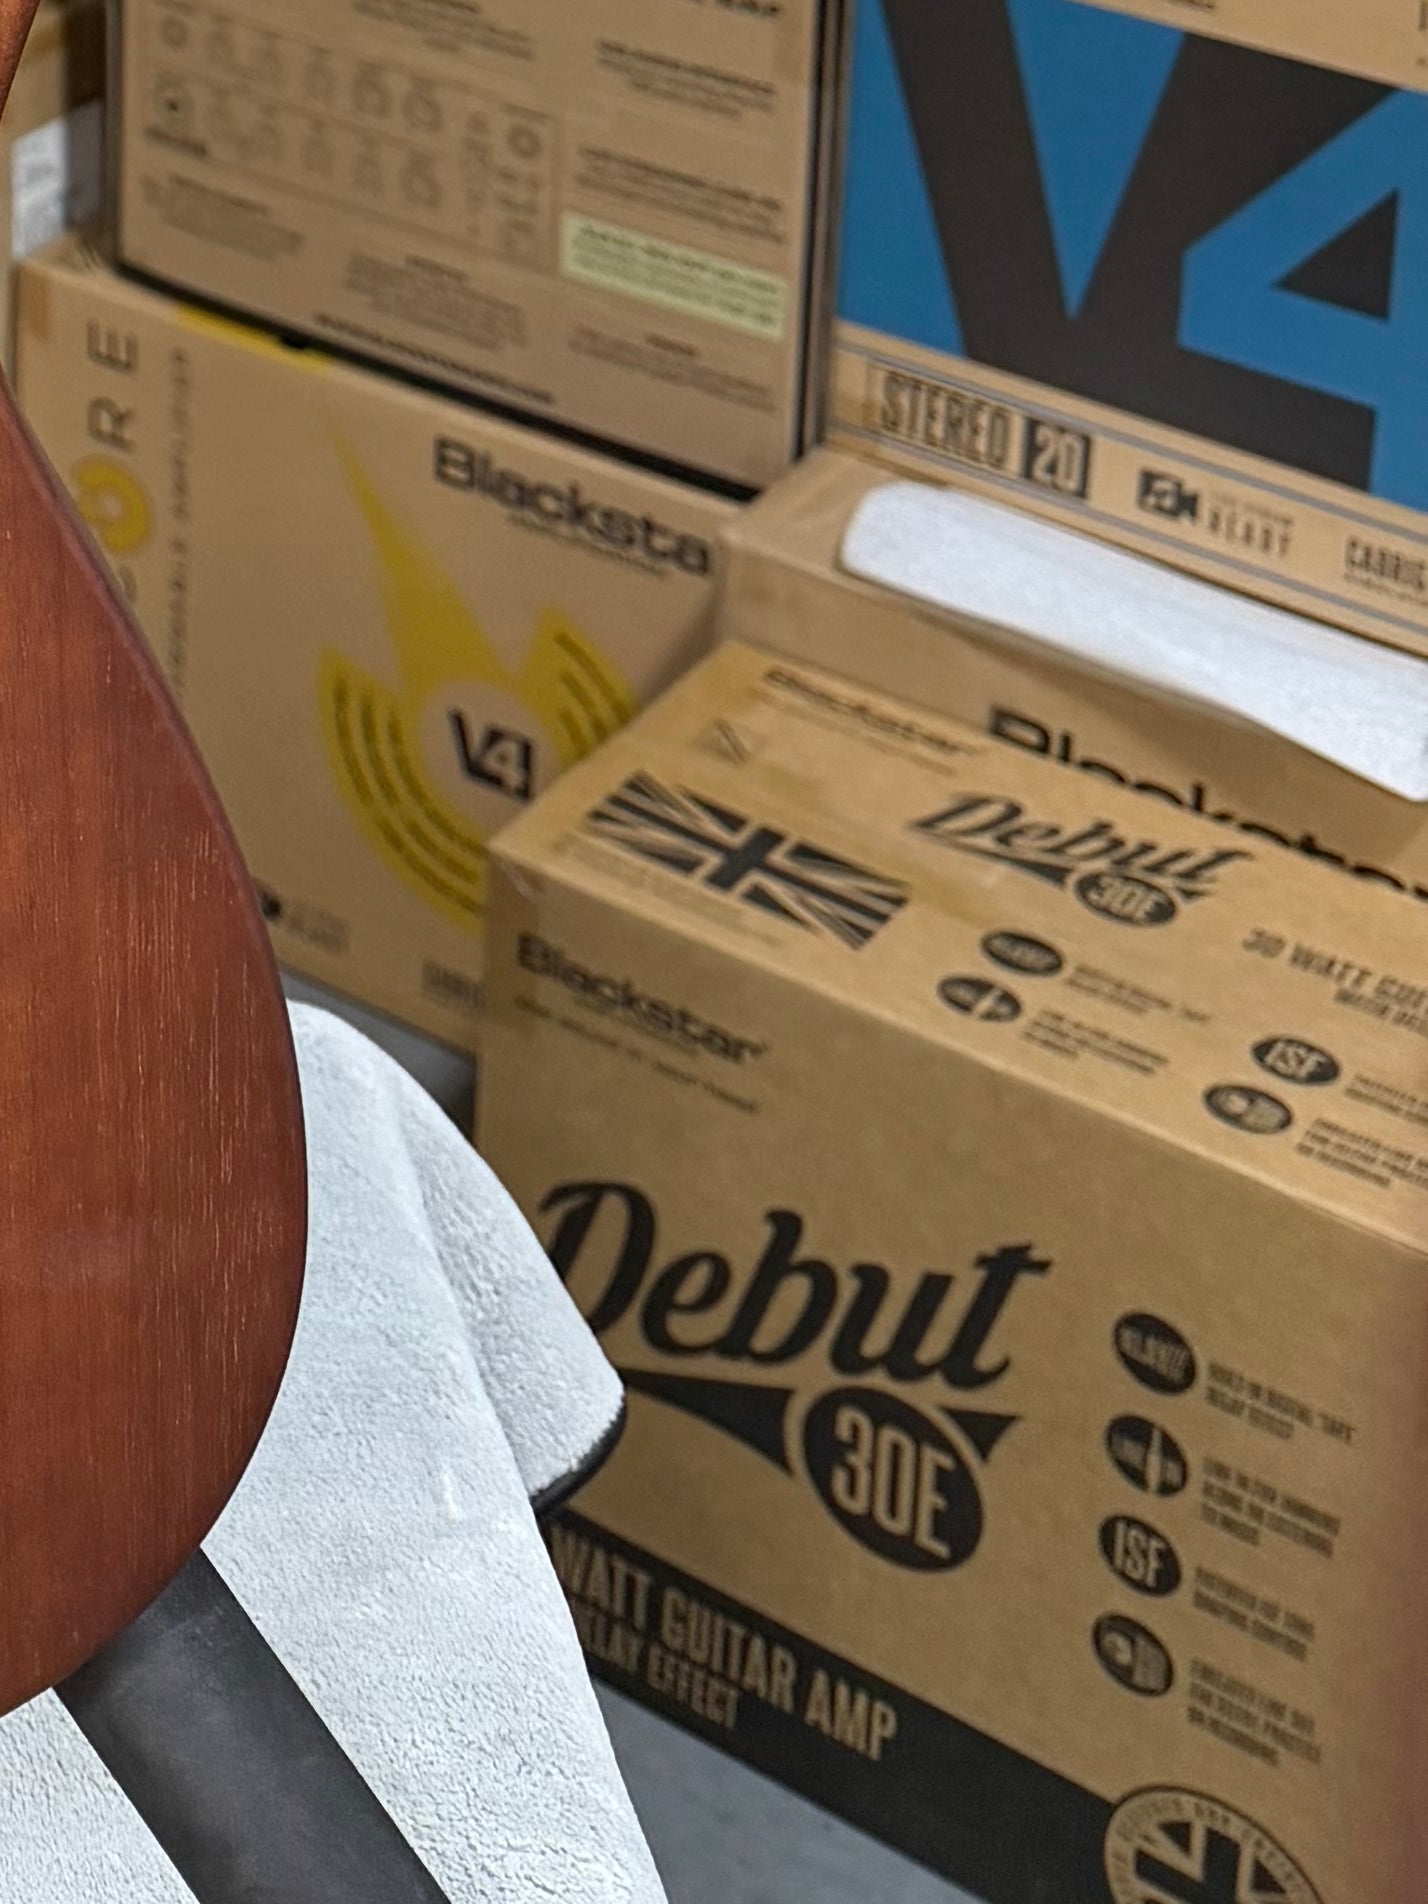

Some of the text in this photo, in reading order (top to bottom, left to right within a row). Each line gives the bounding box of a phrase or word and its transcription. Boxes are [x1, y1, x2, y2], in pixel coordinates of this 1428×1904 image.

[882, 370, 1084, 491] STEREO 20
[434, 435, 709, 575] Blacksta
[450, 709, 534, 800] V4
[912, 793, 1256, 883] Debut
[517, 932, 766, 1064] Blackstar
[1265, 1040, 1329, 1080] ISF
[537, 1180, 1052, 1389] Debut
[831, 1406, 955, 1559] 30E
[1114, 1521, 1166, 1588] ISF
[648, 1641, 740, 1730] EFFECT
[662, 1585, 797, 1714] GUITAR
[804, 1669, 898, 1762] AMP
